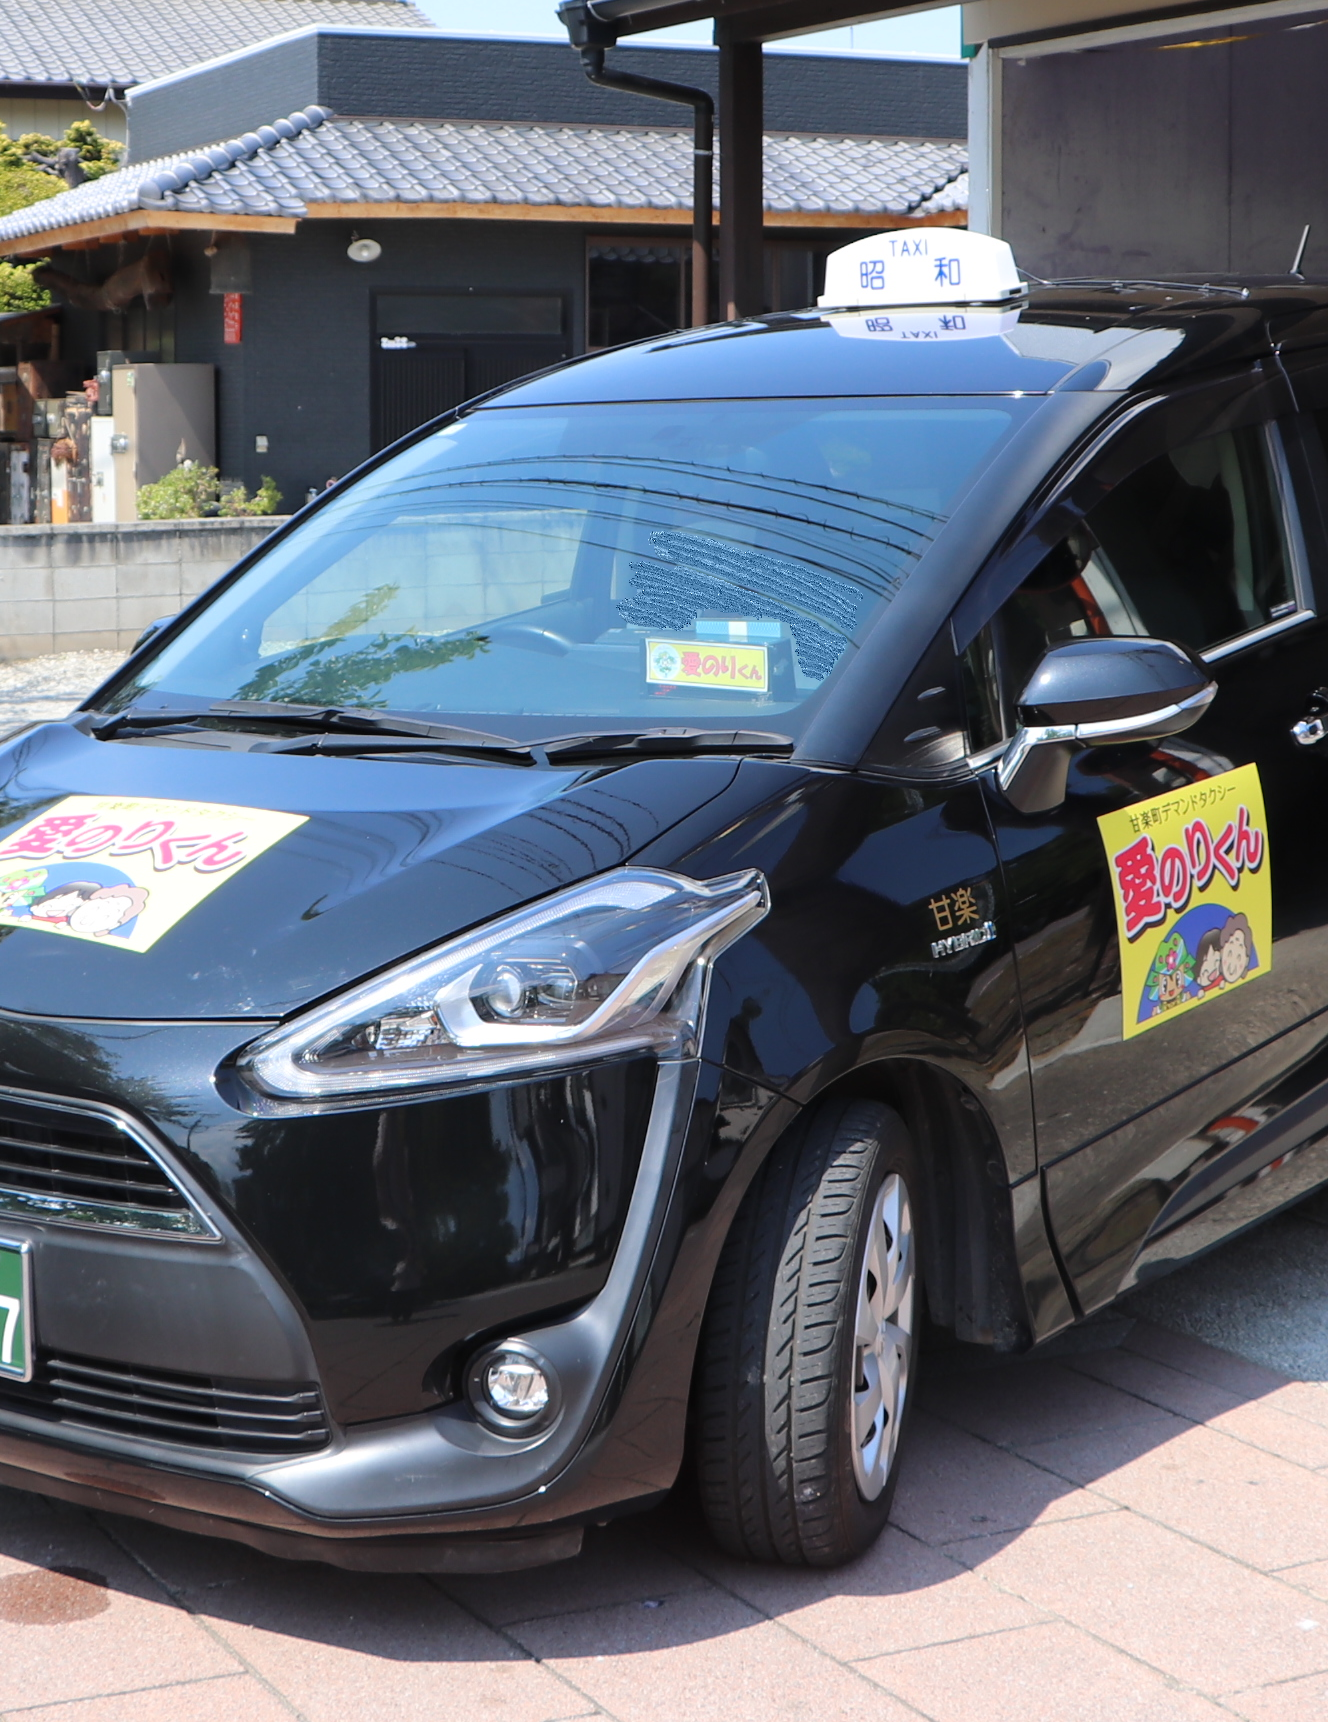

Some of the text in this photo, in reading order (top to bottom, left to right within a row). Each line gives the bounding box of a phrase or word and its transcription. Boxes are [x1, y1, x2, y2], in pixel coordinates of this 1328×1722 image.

[889, 239, 929, 257] TAXI
[859, 256, 961, 290] 昭和
[681, 651, 763, 681] 愛のりくん
[1128, 784, 1237, 834] 甘楽町デマンドタクシー
[1114, 805, 1264, 942] 愛のりくん
[928, 887, 980, 931] 甘楽
